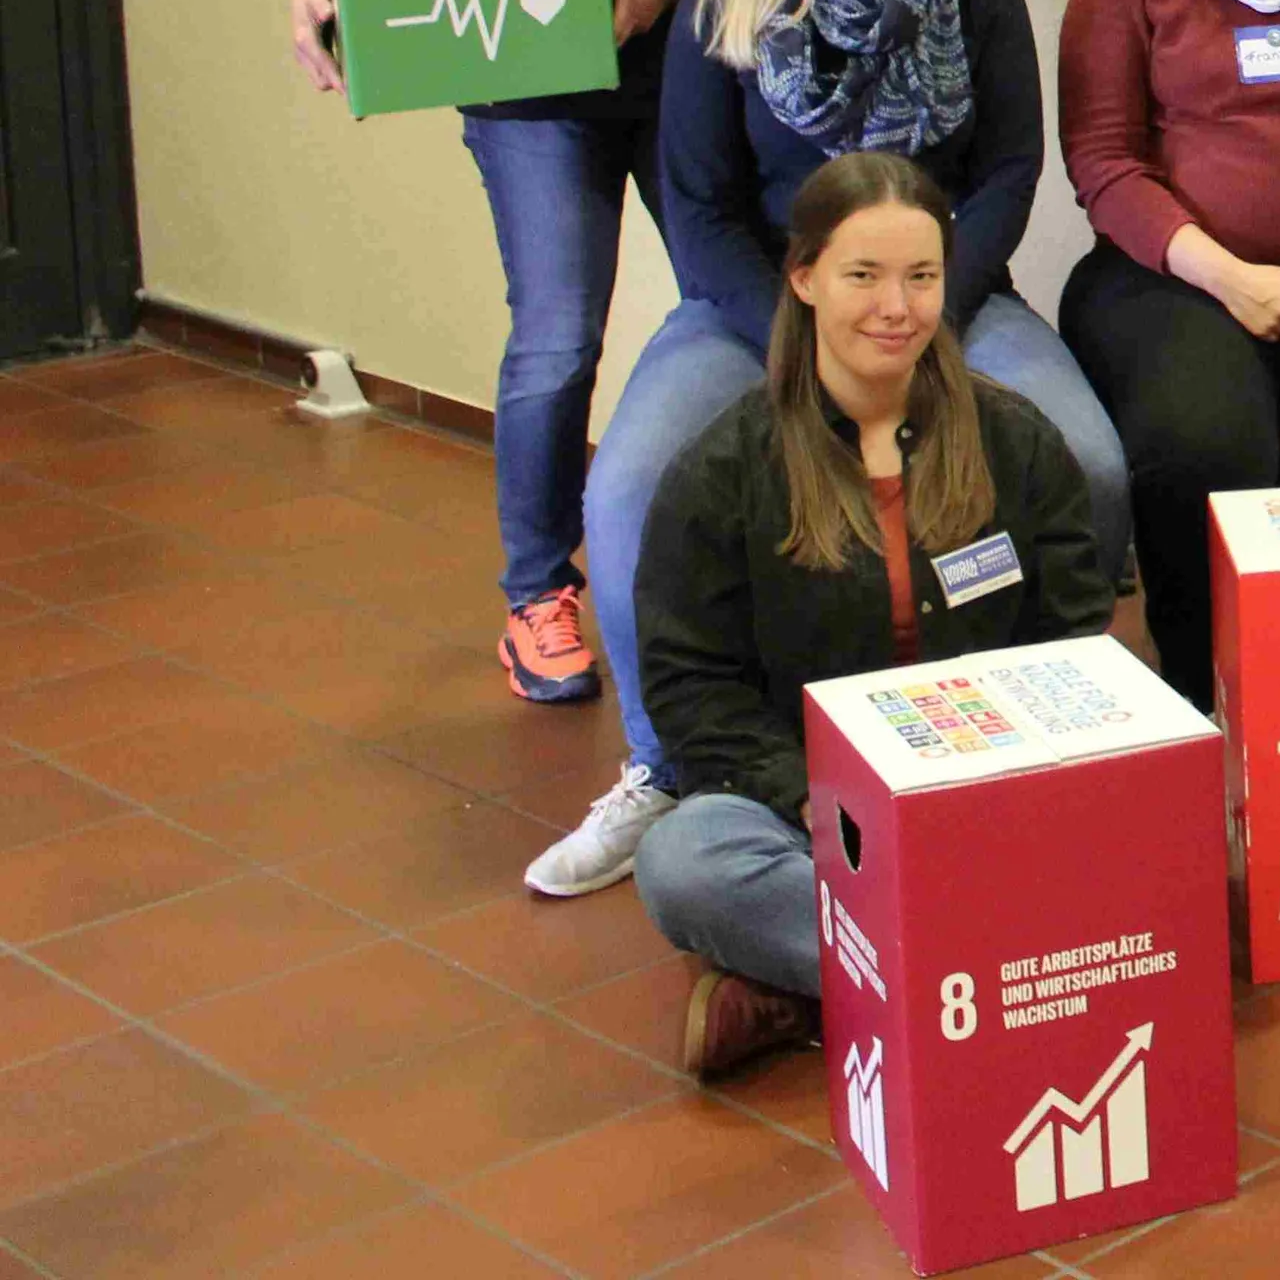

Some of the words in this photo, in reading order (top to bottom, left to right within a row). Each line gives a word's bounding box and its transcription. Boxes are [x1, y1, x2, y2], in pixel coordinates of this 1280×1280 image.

[1044, 659, 1094, 689] ZIELE
[940, 972, 978, 1042] 8
[1000, 957, 1039, 983] GUTE
[1041, 932, 1154, 975] ARBEITSPLÄTZE
[1001, 982, 1033, 1006] UND
[1035, 951, 1177, 1001] WIRTSCHAFTLICHES
[1002, 994, 1088, 1030] WACHSTUM
